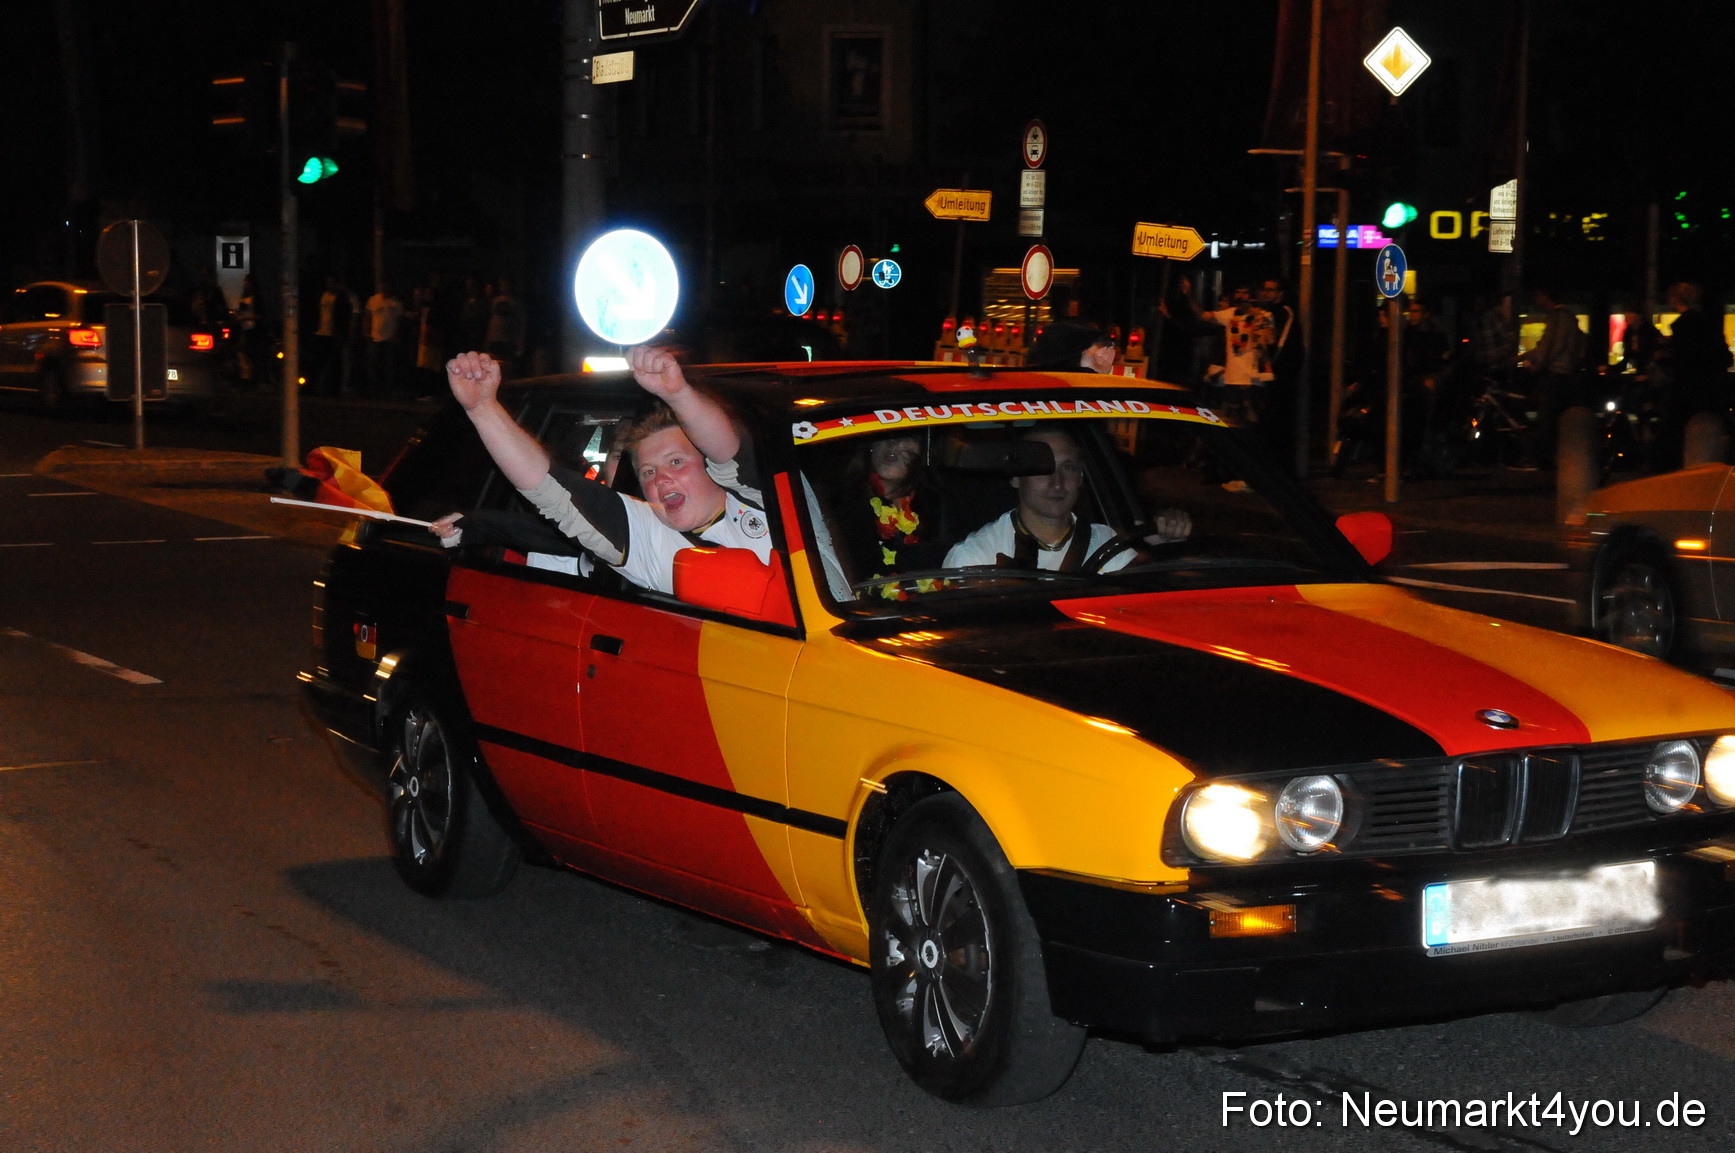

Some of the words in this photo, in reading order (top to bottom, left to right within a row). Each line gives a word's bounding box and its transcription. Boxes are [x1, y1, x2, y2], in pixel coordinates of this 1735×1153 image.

[625, 5, 655, 25] Neumarkt
[940, 196, 986, 215] Umleitung
[1138, 230, 1189, 252] Umleitung
[874, 400, 1151, 424] DEUTSCHLAND
[1433, 944, 1470, 956] Michael
[1472, 941, 1499, 952] Nibler
[1552, 930, 1594, 942] Lauterhofen
